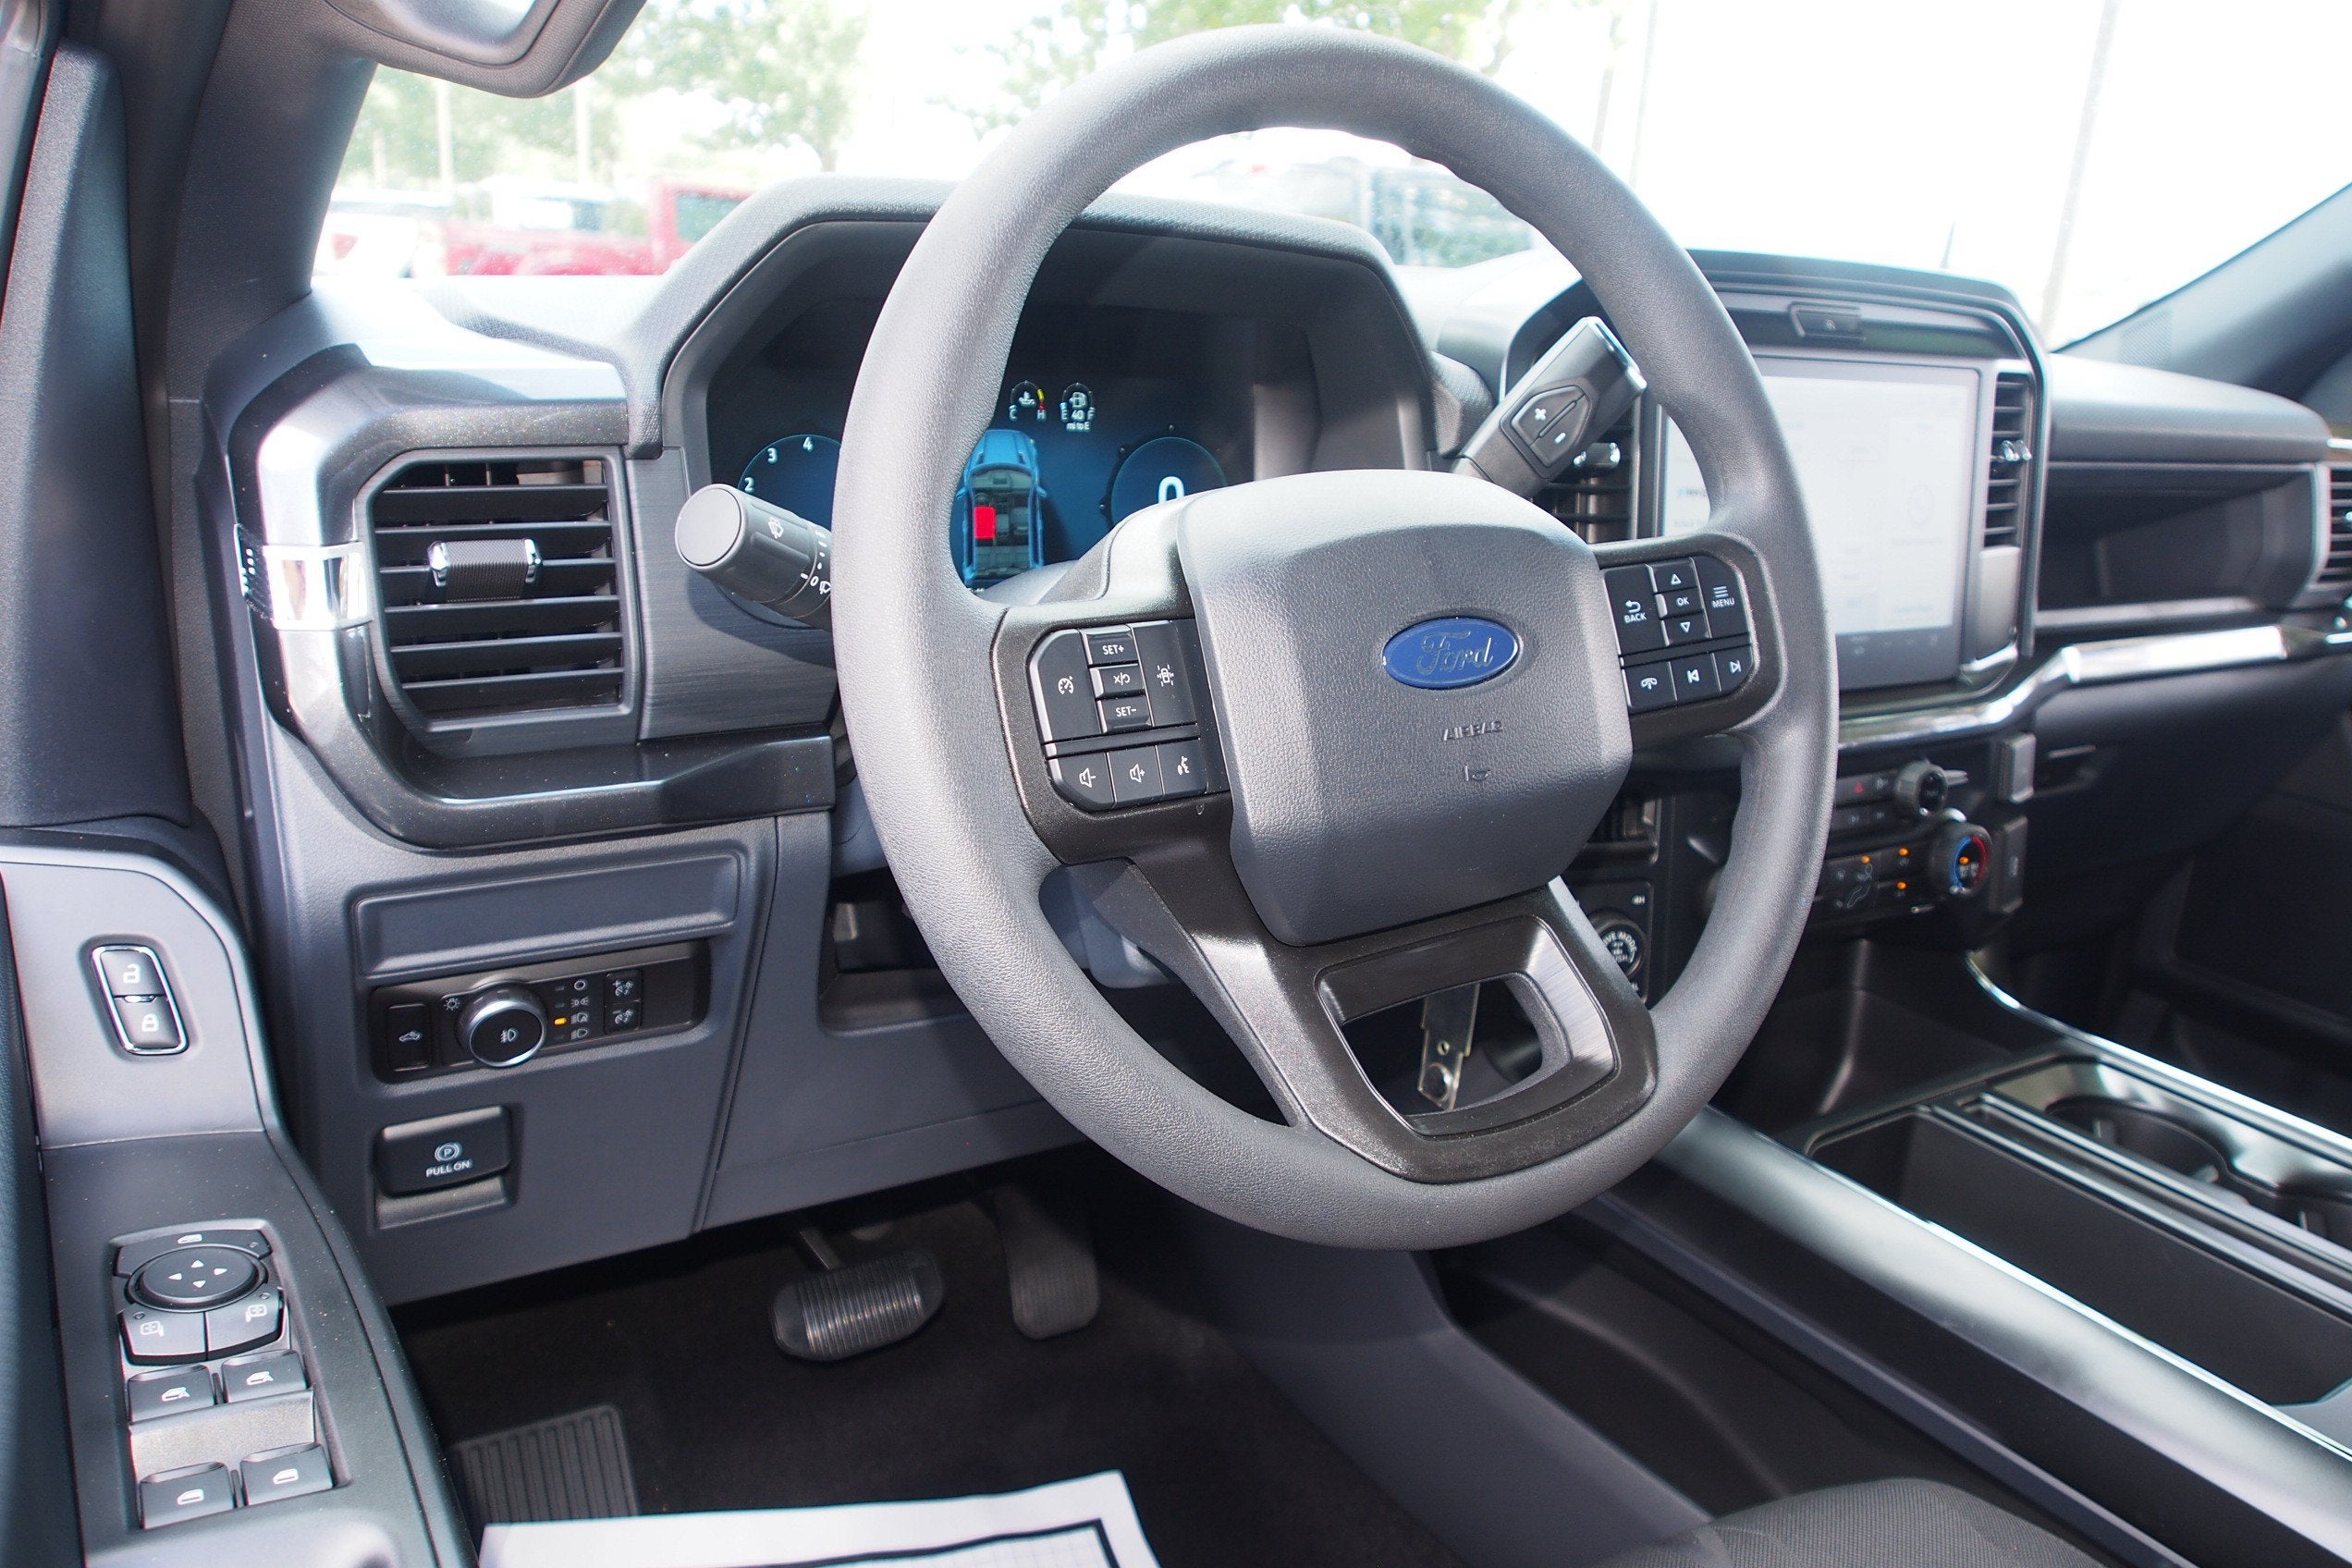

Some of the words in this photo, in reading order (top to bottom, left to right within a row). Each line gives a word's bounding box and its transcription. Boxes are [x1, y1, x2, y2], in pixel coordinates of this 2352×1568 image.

[1036, 409, 1046, 420] H
[1061, 410, 1069, 421] E
[1071, 410, 1085, 421] 40
[802, 436, 814, 452] 4
[766, 447, 778, 463] 3
[744, 477, 754, 493] 2
[1676, 597, 1689, 606] OK
[1712, 598, 1735, 608] MENU
[1624, 613, 1647, 623] BACK
[1416, 630, 1494, 676] Ford
[426, 1165, 452, 1177] PULL
[453, 1159, 471, 1171] ON
